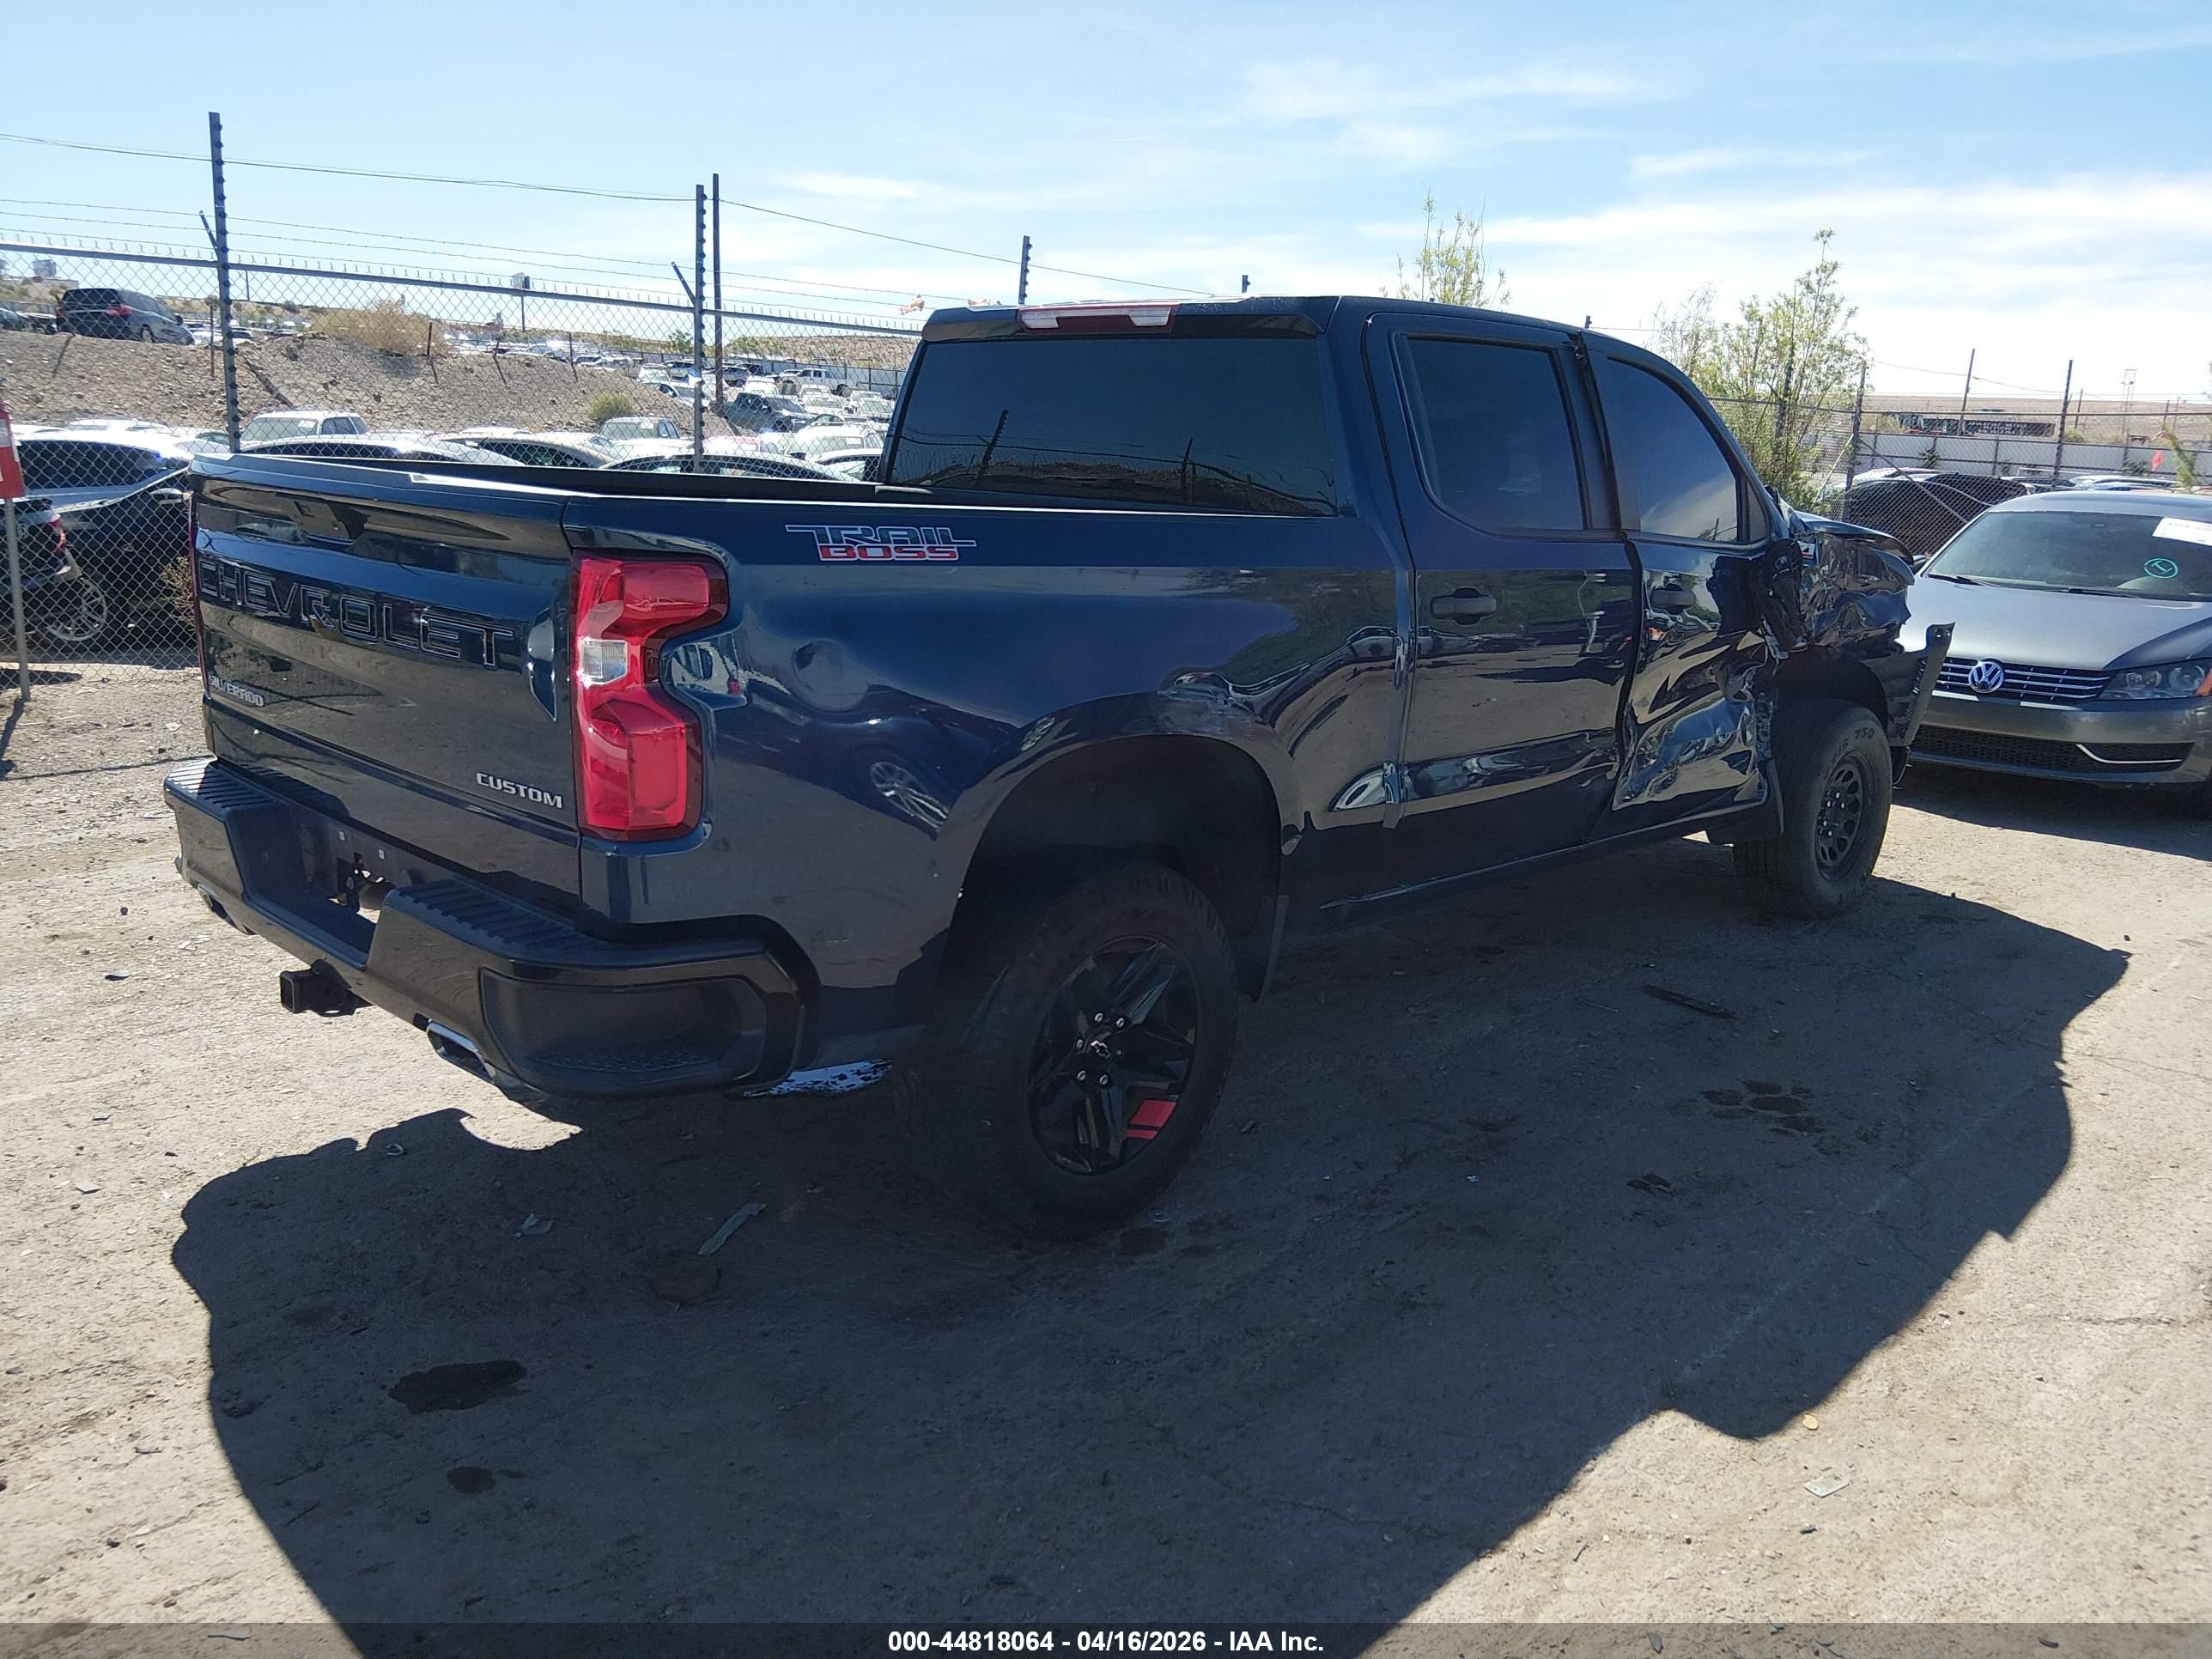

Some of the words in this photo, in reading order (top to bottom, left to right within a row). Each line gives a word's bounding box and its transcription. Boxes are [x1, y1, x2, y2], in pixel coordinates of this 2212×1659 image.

[785, 525, 977, 547] TRAIL
[817, 544, 959, 561] BOSS
[198, 559, 514, 669] CHEVROLET
[207, 674, 265, 708] SILVERADO
[476, 772, 563, 809] CUSTOM
